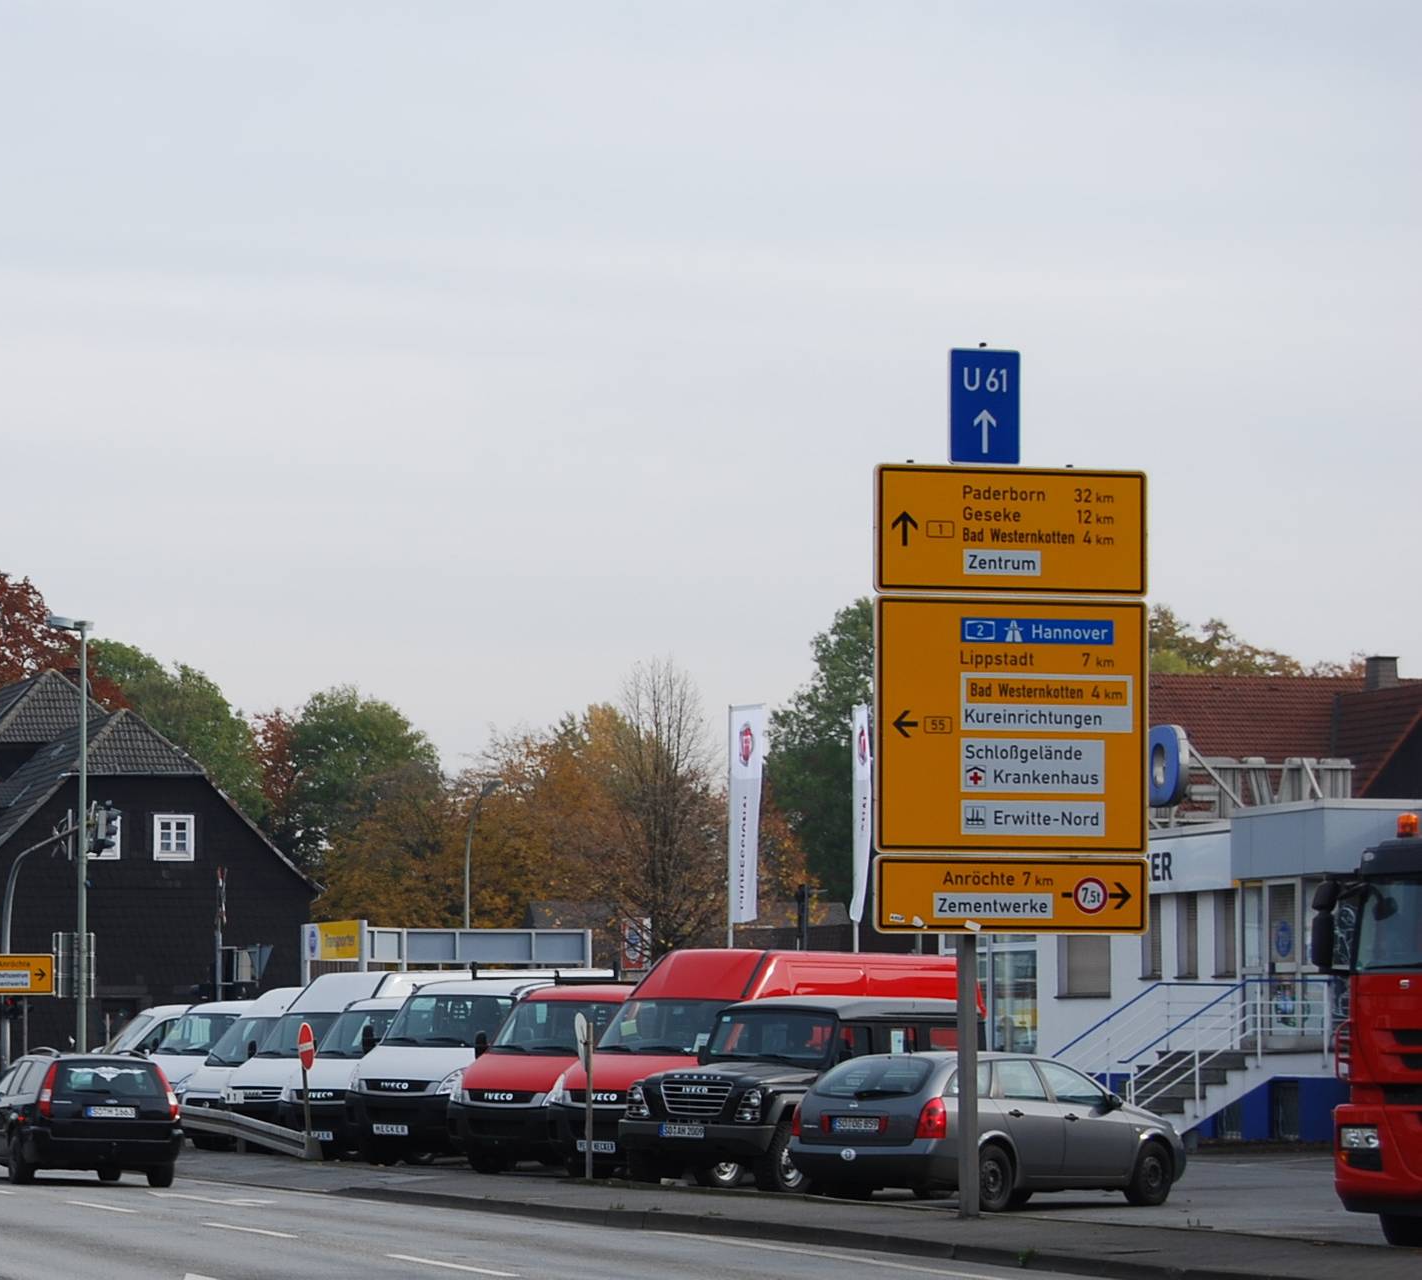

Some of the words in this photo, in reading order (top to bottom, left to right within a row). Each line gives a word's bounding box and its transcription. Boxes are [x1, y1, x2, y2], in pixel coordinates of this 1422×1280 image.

[963, 367, 980, 391] U
[985, 368, 1007, 393] 61
[962, 485, 1046, 502] Paderborn
[1074, 488, 1092, 504] 32
[1095, 492, 1114, 504] km
[962, 506, 1021, 522] Geseke
[1076, 509, 1092, 525] 12
[1095, 513, 1114, 525] km
[962, 528, 984, 543] Bad
[990, 528, 1075, 545] Westernkotten
[1082, 530, 1092, 545] 4
[1095, 534, 1114, 546] km
[968, 554, 1036, 571] Zentrum
[977, 624, 984, 636] 2
[1031, 624, 1108, 640] Hannover
[959, 650, 1034, 669] Lippstadt
[1082, 652, 1091, 667] 7
[1095, 656, 1114, 668] km
[970, 682, 992, 698] Bad
[998, 683, 1084, 700] Westernkotten
[1090, 685, 1100, 700] 4
[1104, 689, 1123, 700] km
[930, 719, 946, 731] 55
[964, 708, 1103, 729] Kureinrichtungen
[964, 744, 1083, 763] Schloßgelände
[993, 769, 1099, 785] Krankenhaus
[993, 810, 1099, 827] Erwitte-Nord
[942, 870, 1015, 887] Anröchte
[1022, 871, 1031, 887] 7
[1034, 875, 1054, 887] km
[937, 897, 1048, 914] Zementwerke
[381, 1081, 409, 1090] IVECO
[682, 1086, 708, 1094] IVECO
[483, 1092, 514, 1101] IVECO
